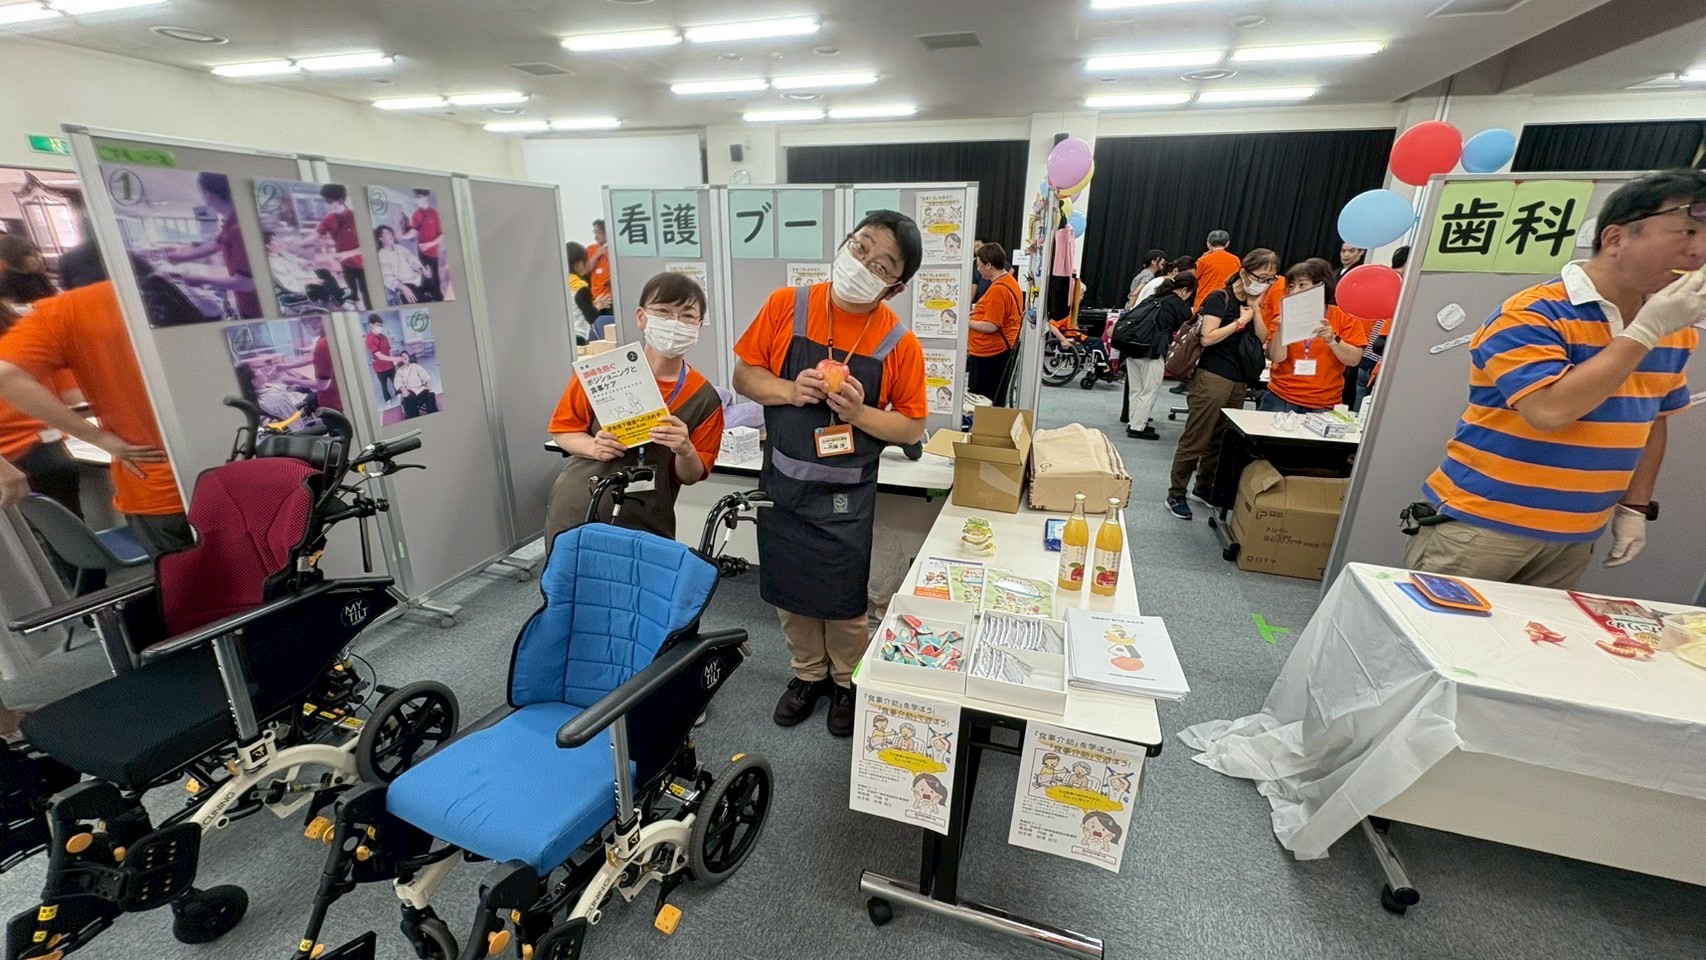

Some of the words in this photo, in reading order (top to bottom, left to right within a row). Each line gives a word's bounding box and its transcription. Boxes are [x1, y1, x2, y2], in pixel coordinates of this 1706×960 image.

[618, 203, 698, 245] 看護
[1438, 198, 1576, 257] 歯科
[586, 366, 637, 386] ポジショニングと
[345, 600, 362, 615] MY
[348, 607, 368, 622] TILT
[704, 659, 718, 676] MY
[706, 668, 721, 685] TILT
